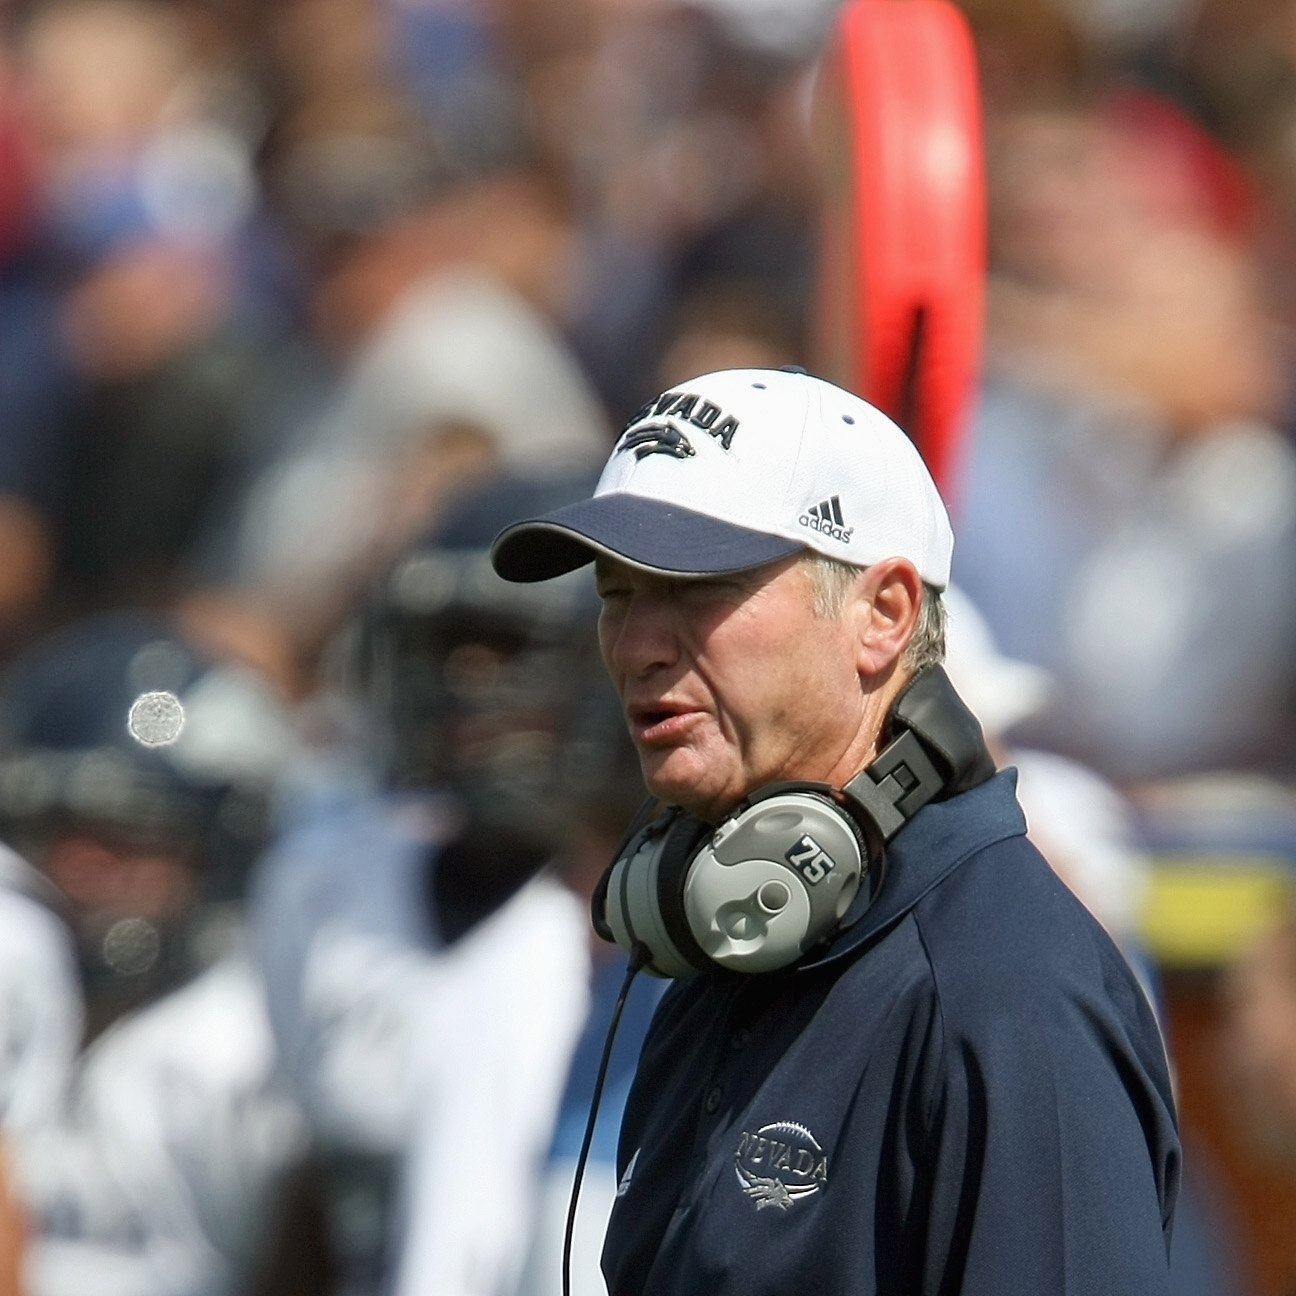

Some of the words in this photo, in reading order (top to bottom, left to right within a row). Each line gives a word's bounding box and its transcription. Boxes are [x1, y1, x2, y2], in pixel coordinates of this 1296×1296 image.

[798, 515, 851, 545] adidas
[789, 835, 836, 884] 75
[735, 1131, 828, 1182] NEVADA
